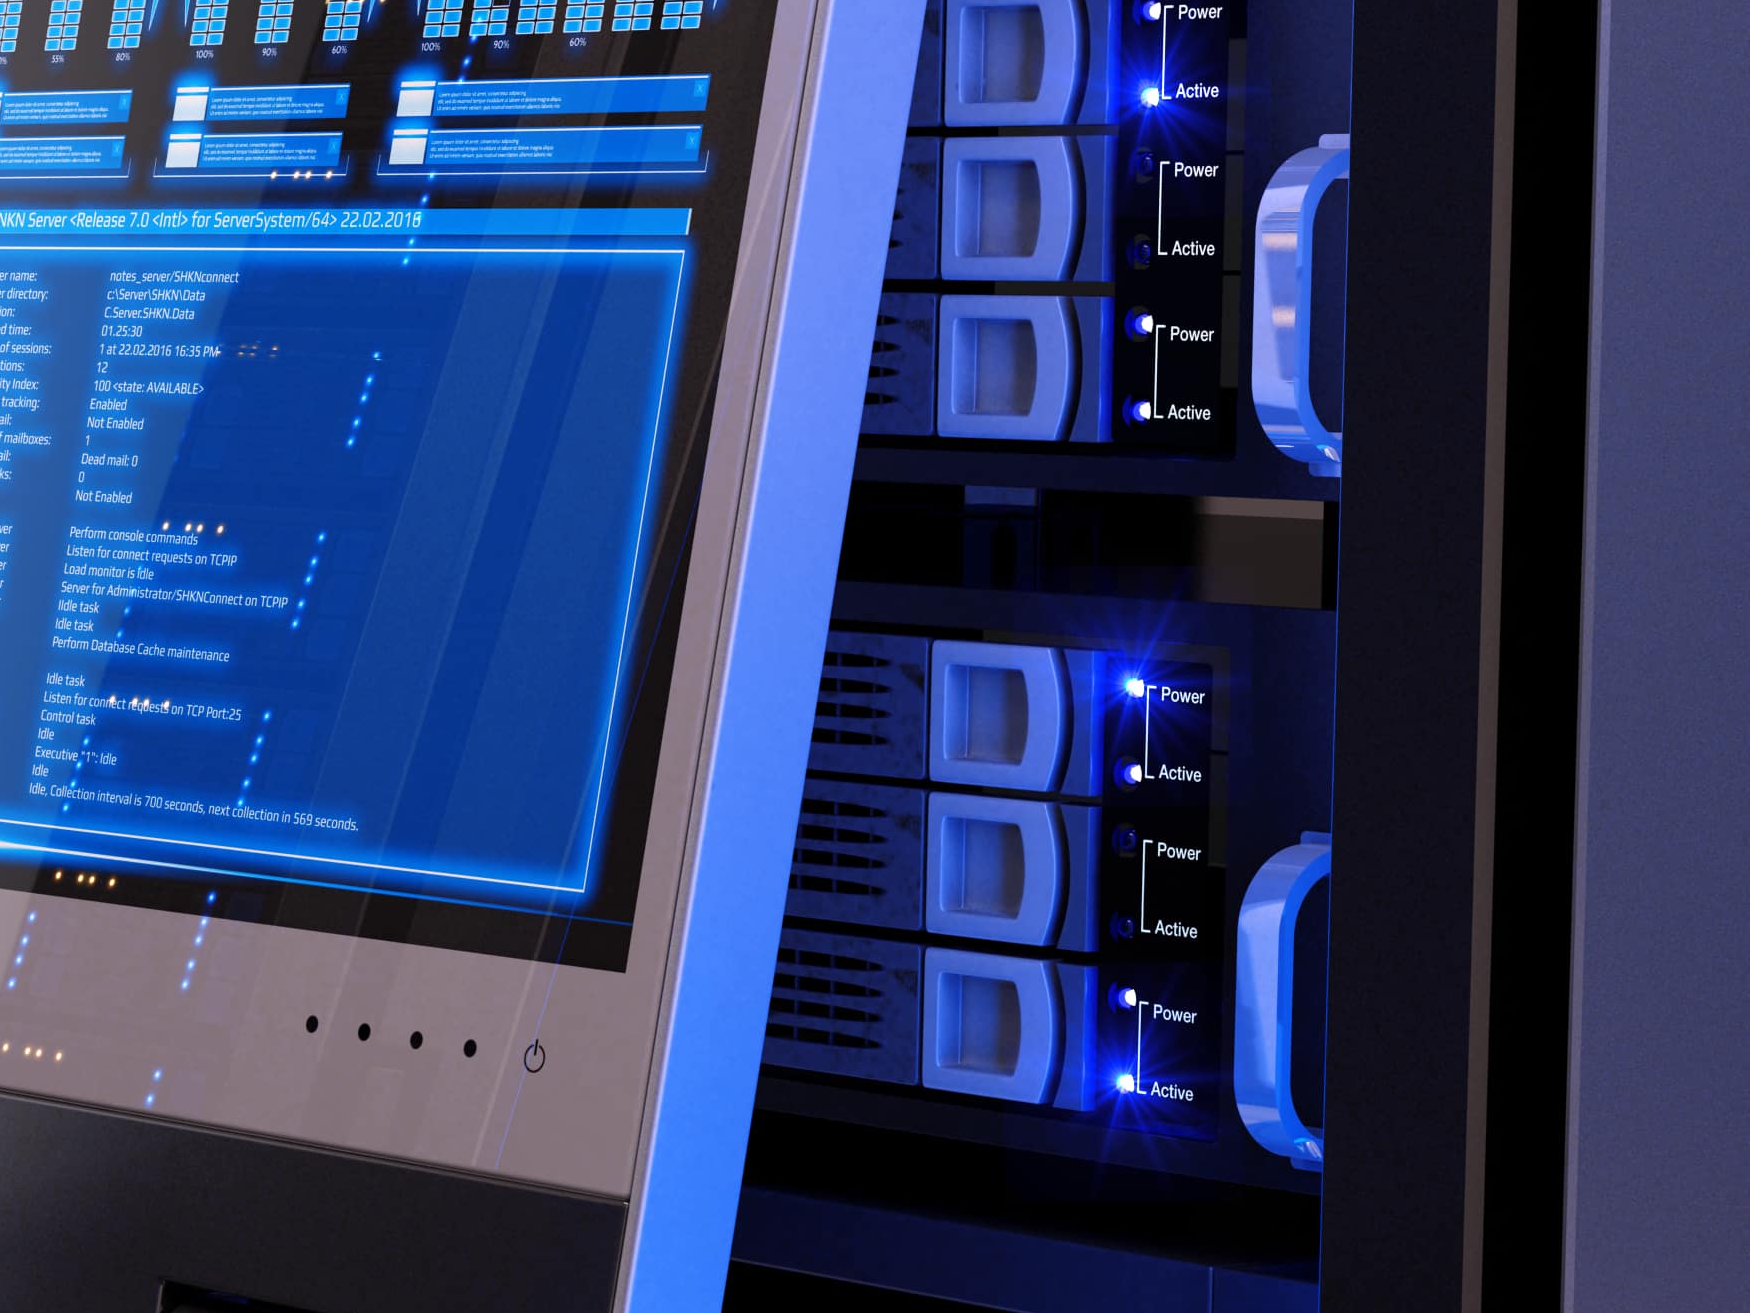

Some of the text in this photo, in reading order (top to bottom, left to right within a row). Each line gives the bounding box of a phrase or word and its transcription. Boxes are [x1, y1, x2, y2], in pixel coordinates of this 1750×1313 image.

[1178, 4, 1223, 20] Power
[51, 54, 65, 63] 55%
[115, 52, 131, 62] 80%
[1175, 82, 1220, 99] Active
[1174, 161, 1219, 178] Power
[27, 211, 68, 228] Server
[69, 211, 126, 228] <Release
[130, 211, 150, 228] 7.0
[152, 211, 189, 228] <Intl>
[191, 210, 212, 228] for
[213, 211, 338, 231] ServerSystem/64>
[340, 211, 422, 228] 22.02.2016
[1171, 240, 1215, 256] Active
[9, 272, 38, 282] name:
[109, 270, 240, 284] notes_server/SHKNconnect
[6, 287, 49, 303] directory:
[106, 288, 206, 302] c:\Server\SHKN\Data
[104, 306, 195, 320] C.Server.SHKN.Data
[8, 324, 32, 336] time:
[1170, 325, 1215, 342] Power
[0, 340, 11, 353] of
[11, 342, 52, 355] sessions:
[99, 343, 219, 358] 1 at 22.02.2016 16:35 PM
[97, 361, 109, 374] 12
[1167, 403, 1211, 421] Active
[69, 526, 202, 546] Perform console commands
[1161, 686, 1206, 705] Power
[1158, 763, 1202, 783] Active
[29, 782, 359, 831] Idle, Collection interval is 700 seconds, next collection in 569 seconds.
[1157, 841, 1202, 861] Power
[1154, 919, 1198, 939] Active
[1153, 1003, 1198, 1024] Power
[1150, 1081, 1194, 1102] Active
